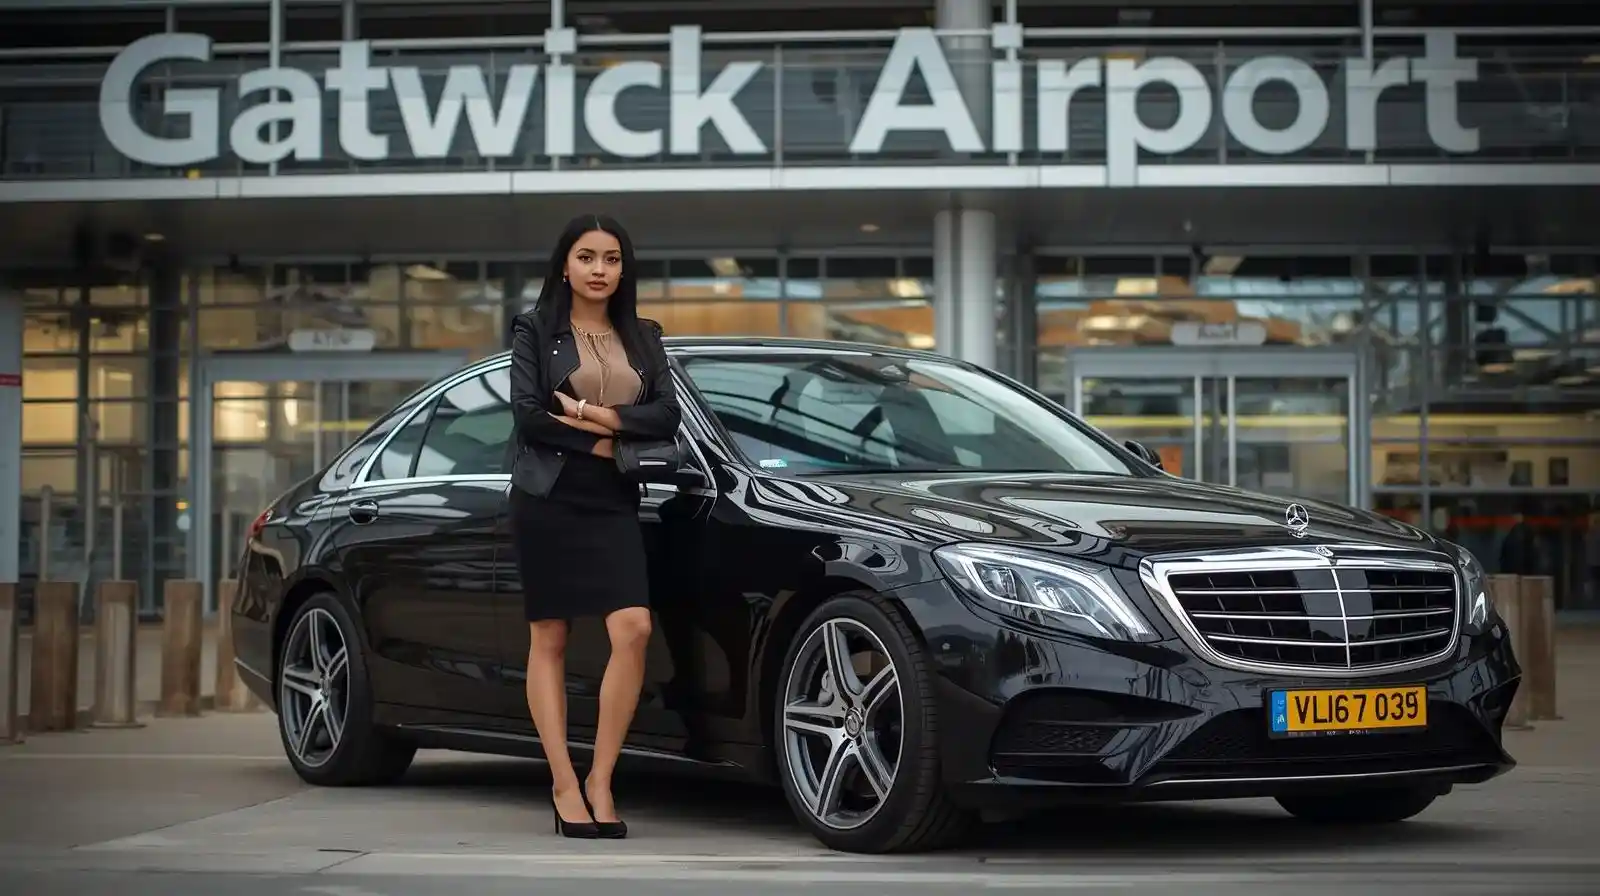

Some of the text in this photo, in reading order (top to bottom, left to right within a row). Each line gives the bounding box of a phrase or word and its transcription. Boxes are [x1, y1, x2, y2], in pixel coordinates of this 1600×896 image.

[99, 23, 1480, 186] Gatwick Airport
[1375, 690, 1419, 721] 039
